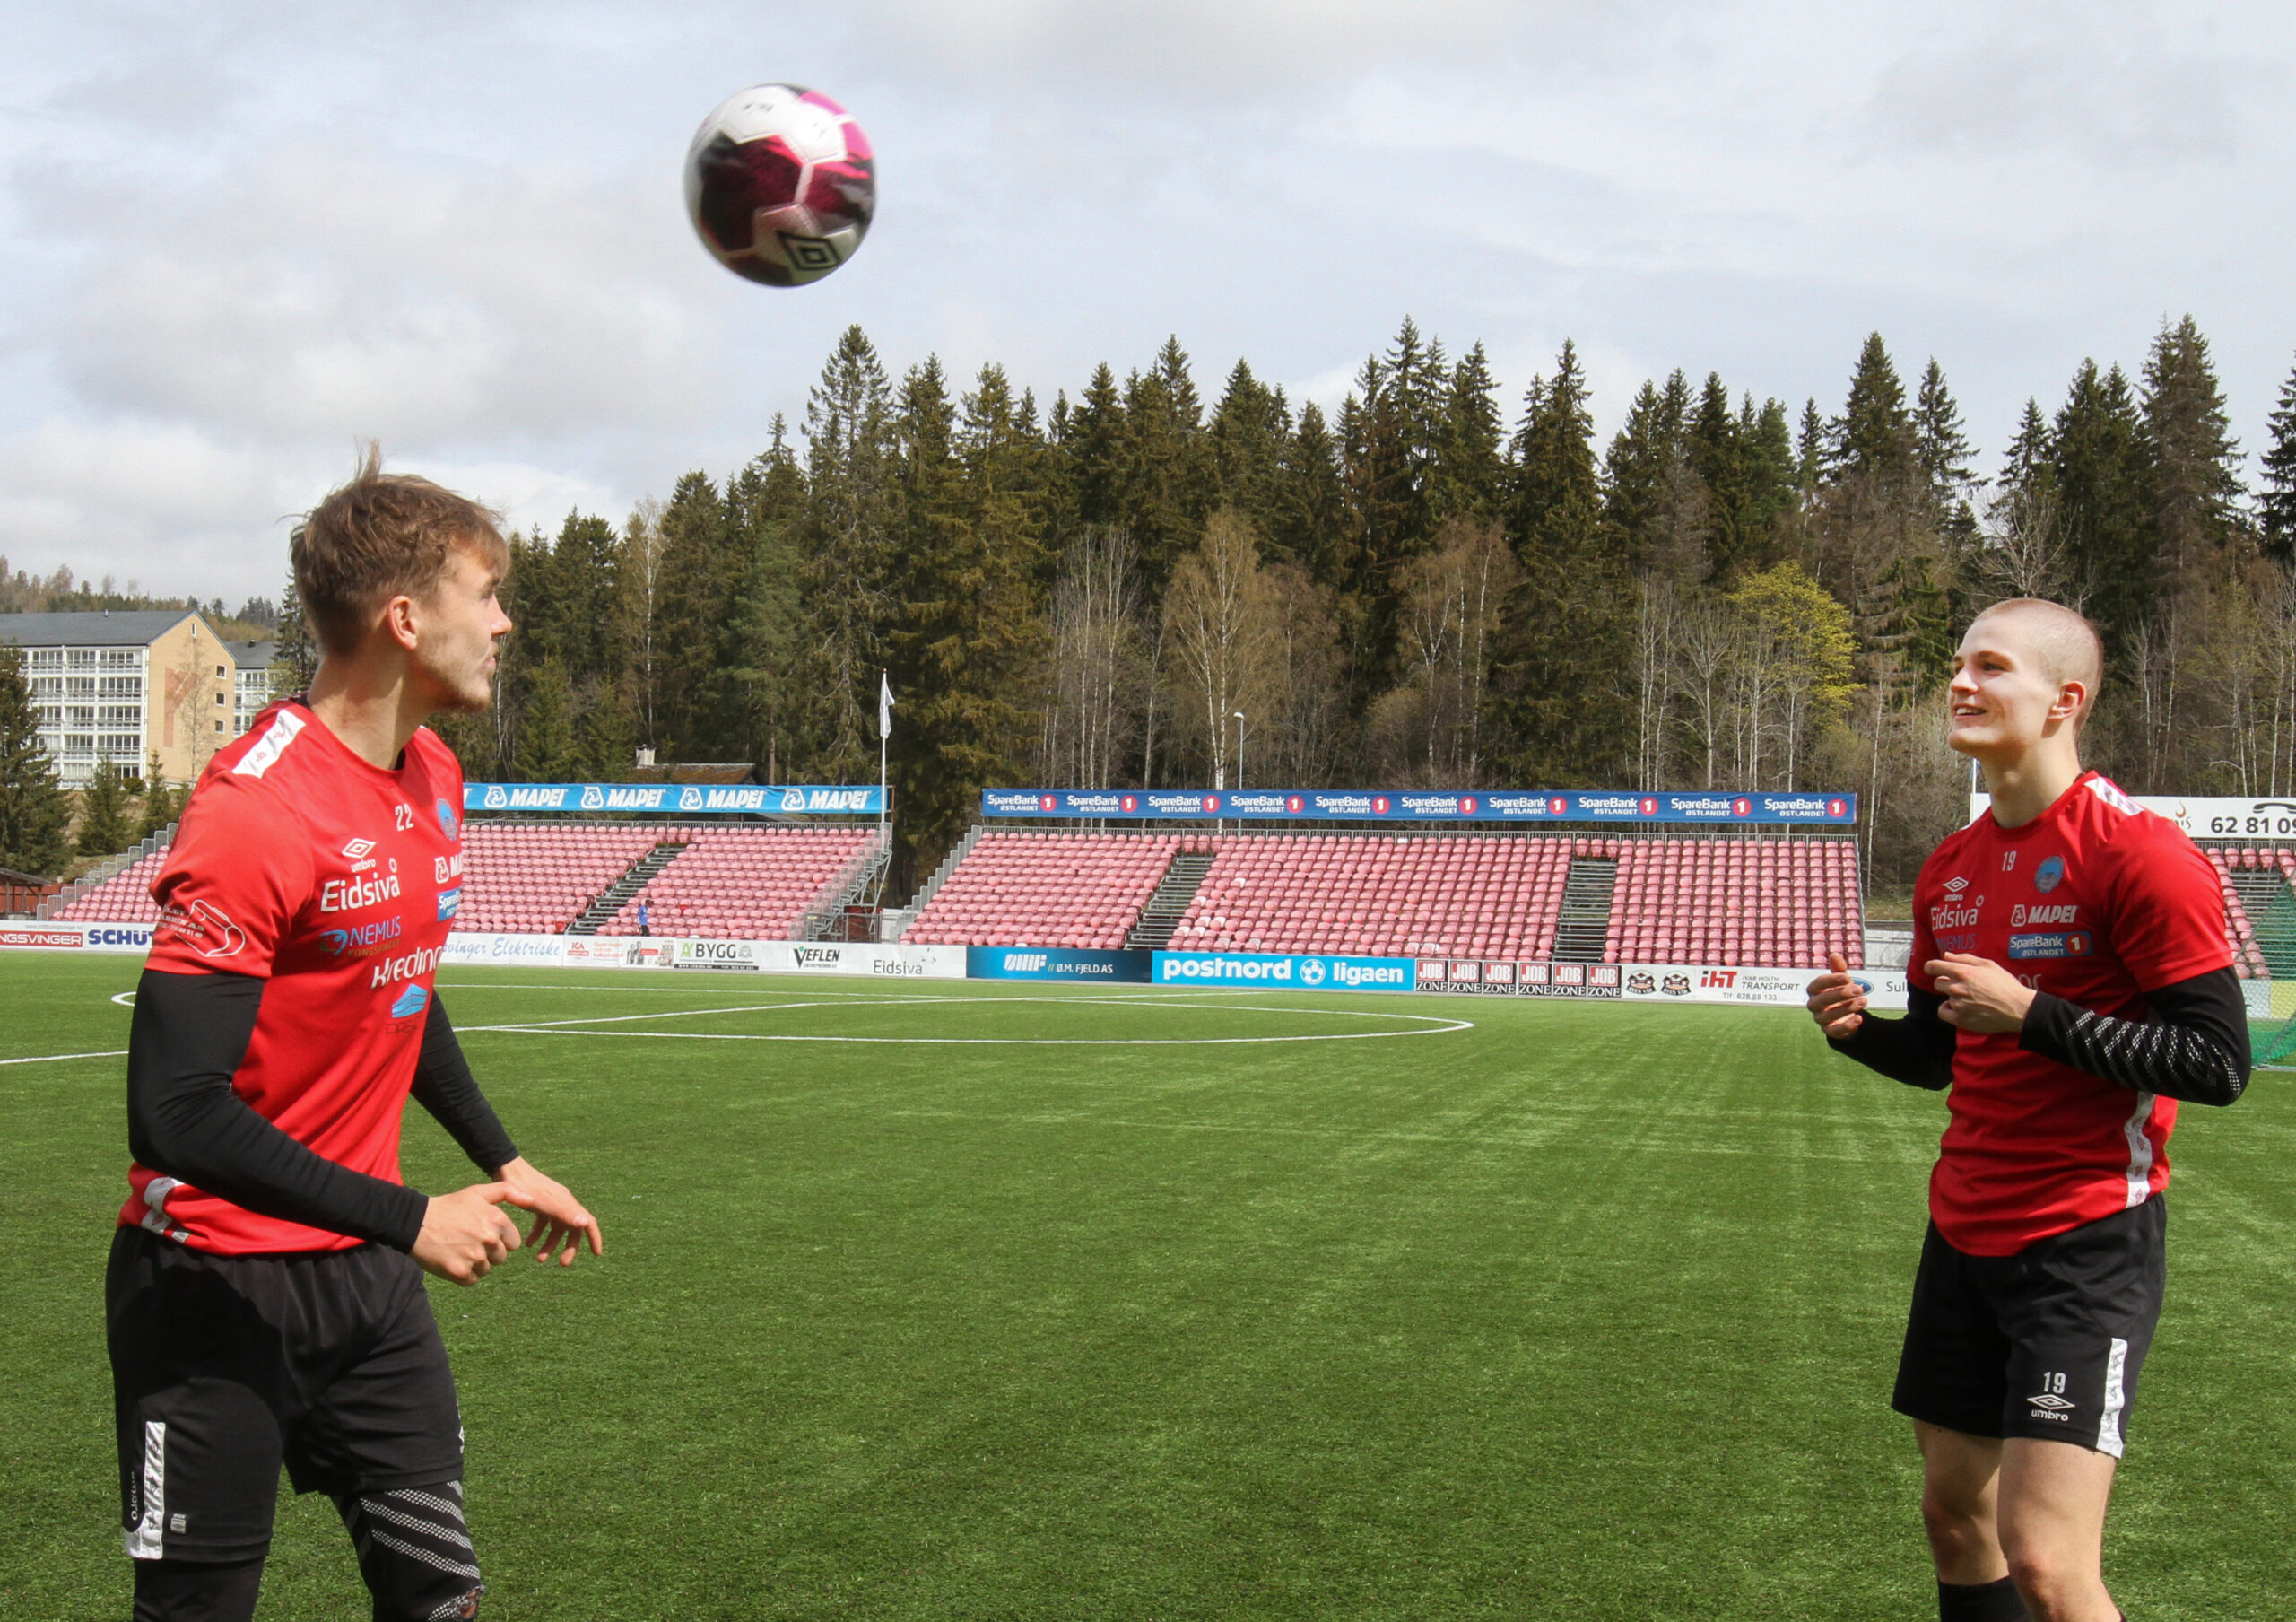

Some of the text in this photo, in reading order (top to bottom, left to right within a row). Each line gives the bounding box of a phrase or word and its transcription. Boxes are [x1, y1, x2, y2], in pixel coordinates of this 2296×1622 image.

[509, 789, 566, 807] MAPEI
[607, 789, 664, 807] MAPEI
[706, 789, 764, 808] MAPEI
[808, 790, 866, 809] MAPEI
[987, 795, 1051, 809] SpareBank 1
[1067, 796, 1132, 809] SpareBank 1
[1148, 796, 1214, 809] SpareBank 1
[1231, 796, 1298, 810] SpareBank 1
[1315, 797, 1384, 810] SpareBank 1
[1402, 797, 1470, 810] SpareBank 1
[1490, 798, 1560, 811] SpareBank 1
[1578, 798, 1651, 812] SpareBank 1
[1671, 798, 1745, 813] SpareBank 1
[1764, 799, 1839, 814] SpareBank 1
[395, 804, 414, 831] 22
[2211, 817, 2238, 833] 62
[2246, 817, 2269, 833] 81
[351, 859, 376, 873] umbro
[2002, 850, 2017, 871] 19
[321, 872, 401, 911] Eidsiva
[1931, 904, 1979, 931] Eidsiva
[2027, 905, 2077, 924] MAPEI
[350, 915, 402, 946] NEMUS
[492, 937, 561, 957] Elektriske
[2011, 936, 2080, 951] SpareBank 1
[696, 944, 736, 959] BYGG
[794, 948, 841, 969] VEFLEN
[2022, 948, 2064, 957] ØSTLANDET
[874, 959, 923, 974] Eidsiva
[1076, 964, 1100, 974] FJELD
[1100, 964, 1113, 973] AS
[1163, 958, 1403, 986] postnord ligaen
[1420, 963, 1443, 979] JOB
[1453, 964, 1477, 981] JOB
[1486, 964, 1511, 981] JOB
[1522, 965, 1546, 982] JOB
[1556, 967, 1580, 983] JOB
[1590, 968, 1616, 984] JOB
[1417, 981, 1447, 991] ZONE
[1450, 983, 1481, 992] ZONE
[1483, 984, 1515, 993] ZONE
[1519, 985, 1551, 995] ZONE
[1553, 987, 1585, 996] ZONE
[1587, 988, 1620, 997] ZONE
[1741, 981, 1800, 991] TRANSPORT
[2044, 1372, 2066, 1394] 19
[2031, 1409, 2069, 1422] umbro
